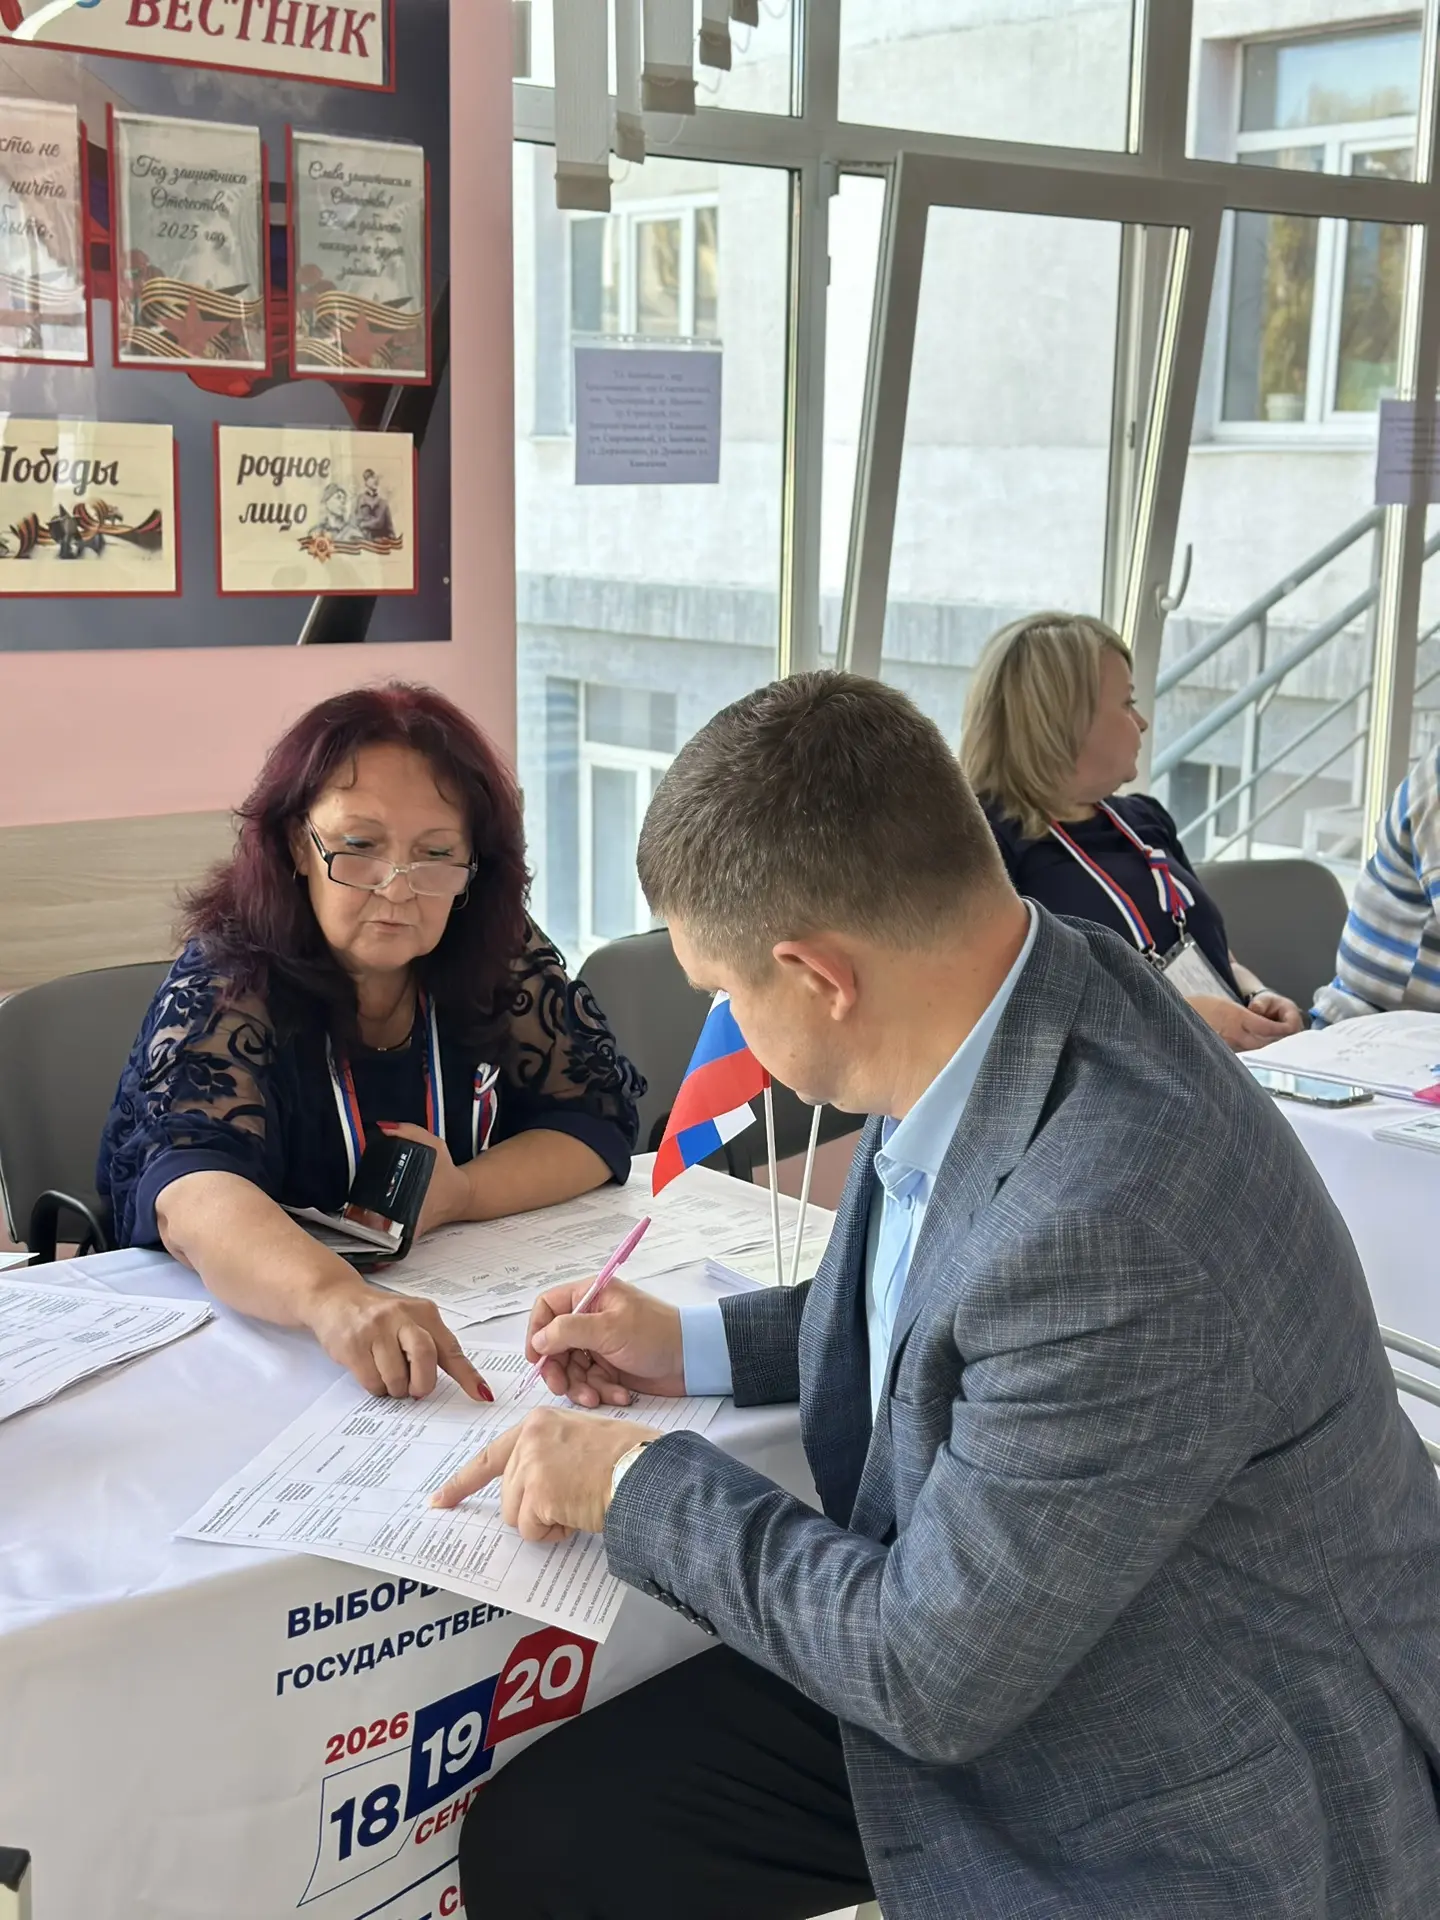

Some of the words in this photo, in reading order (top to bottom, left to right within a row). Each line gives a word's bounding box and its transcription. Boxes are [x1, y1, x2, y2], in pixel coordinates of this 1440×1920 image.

[126, 0, 376, 58] ВЕСТНИК
[39, 143, 61, 157] не
[130, 155, 166, 184] Год
[168, 168, 248, 186] защитника
[308, 160, 345, 181] Слава
[9, 179, 67, 198] ничто
[157, 221, 200, 241] 2025
[204, 230, 227, 250] год
[236, 453, 330, 487] родное
[238, 502, 307, 533] лицо
[276, 1602, 512, 1697] ГОСУДАРСТВЕН
[324, 1711, 410, 1766] 2026
[330, 1783, 402, 1862] 18
[421, 1710, 484, 1791] 19
[497, 1643, 585, 1722] 20
